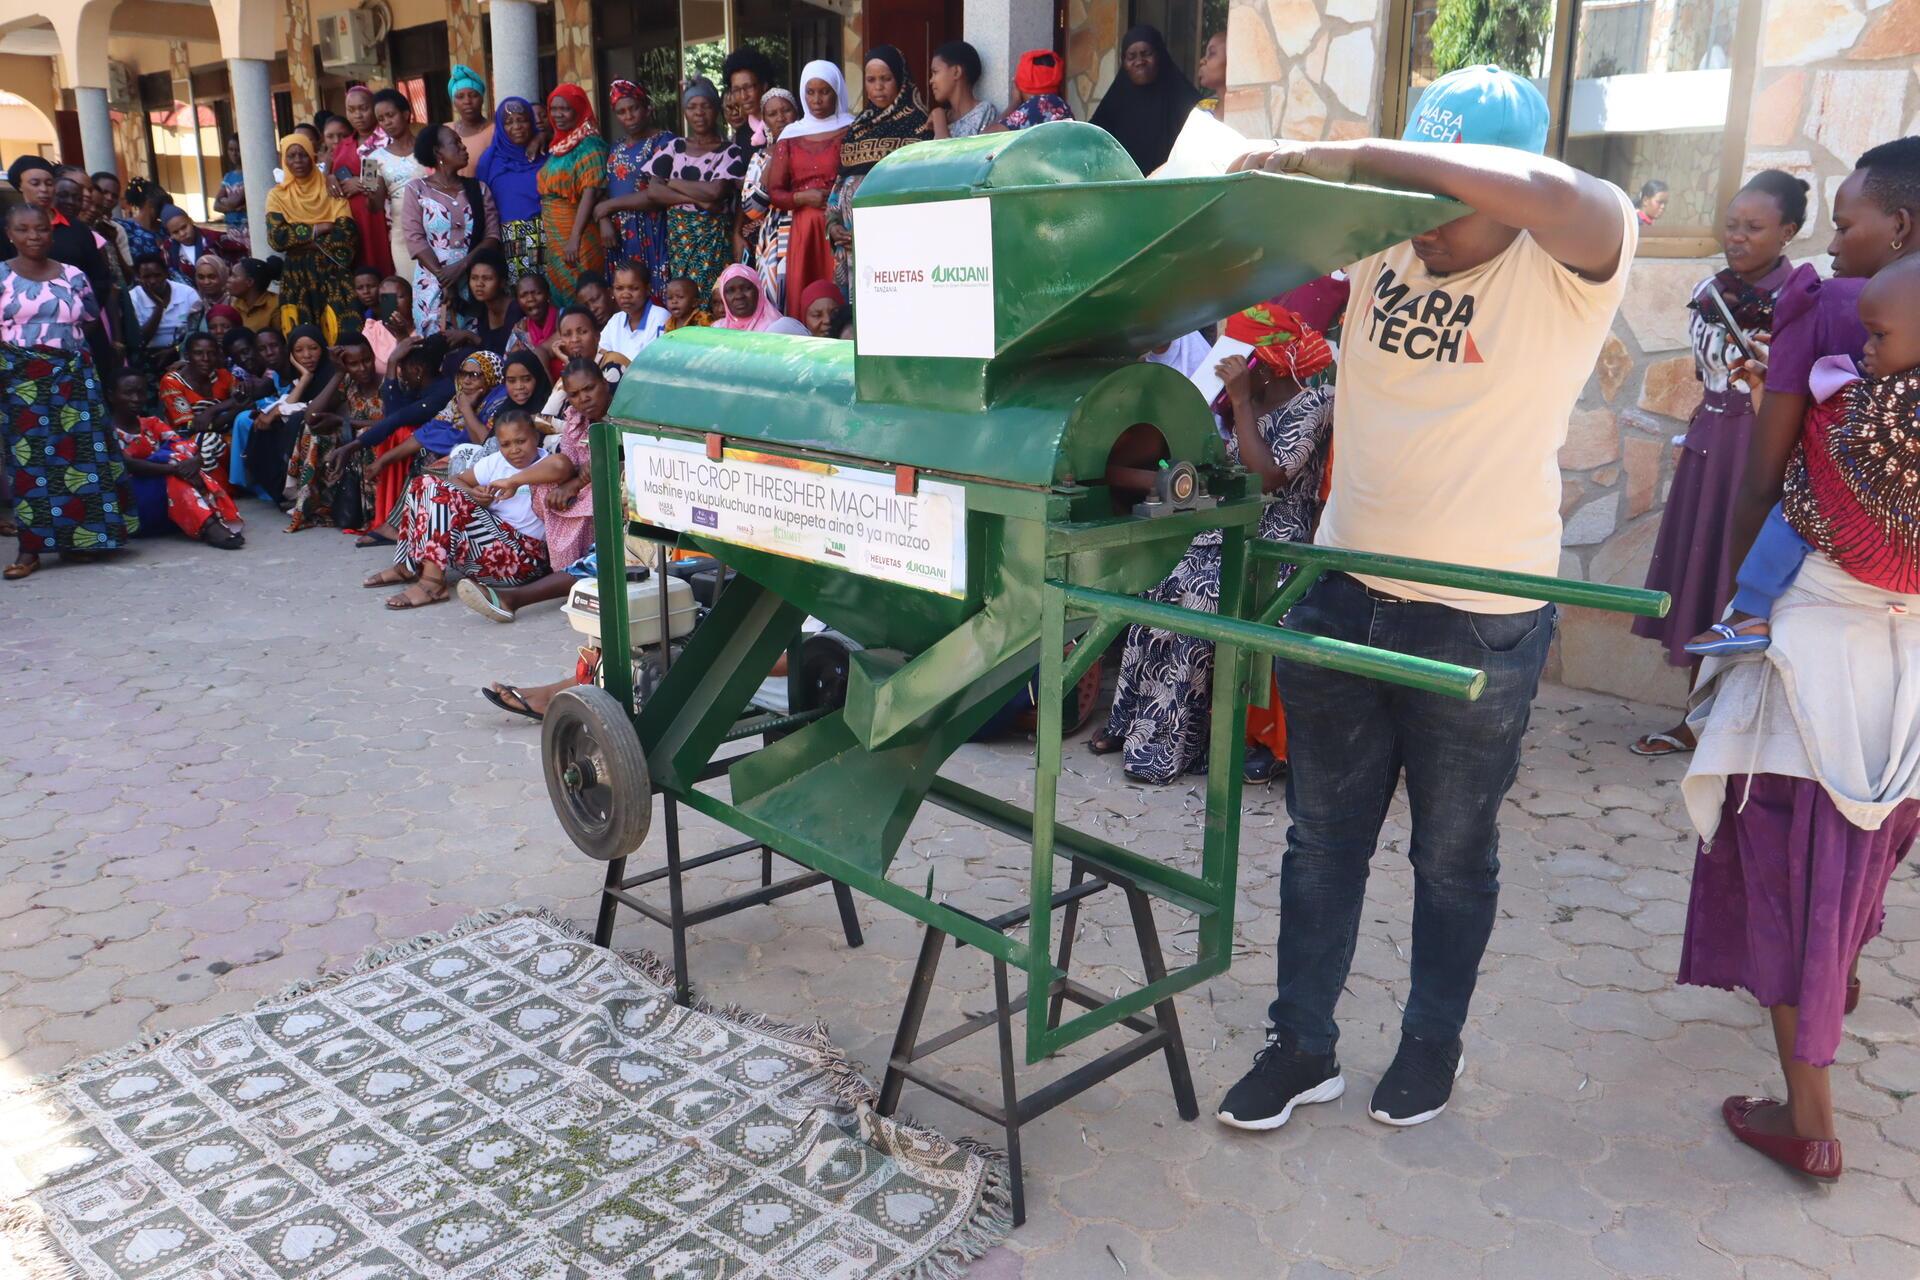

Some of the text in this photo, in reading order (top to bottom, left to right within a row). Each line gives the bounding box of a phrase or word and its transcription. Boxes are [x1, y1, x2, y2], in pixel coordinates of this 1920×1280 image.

[1416, 117, 1457, 143] TECH
[874, 270, 924, 284] HELVETAS
[931, 264, 989, 283] UKIJANI
[1368, 306, 1463, 363] TECH
[649, 456, 918, 528] MULTI-CROP THRESHER MACHINE
[643, 480, 683, 501] Mashine
[684, 489, 697, 508] ya
[696, 488, 756, 516] kupukuchua
[758, 505, 772, 519] na
[773, 504, 826, 533] kupepeta
[829, 517, 854, 536] aina
[856, 522, 864, 538] 9
[865, 526, 883, 545] ya
[884, 530, 931, 552] mazao
[831, 541, 846, 553] TARI
[870, 553, 902, 569] HELVETAS
[906, 560, 947, 578] UKIJANI
